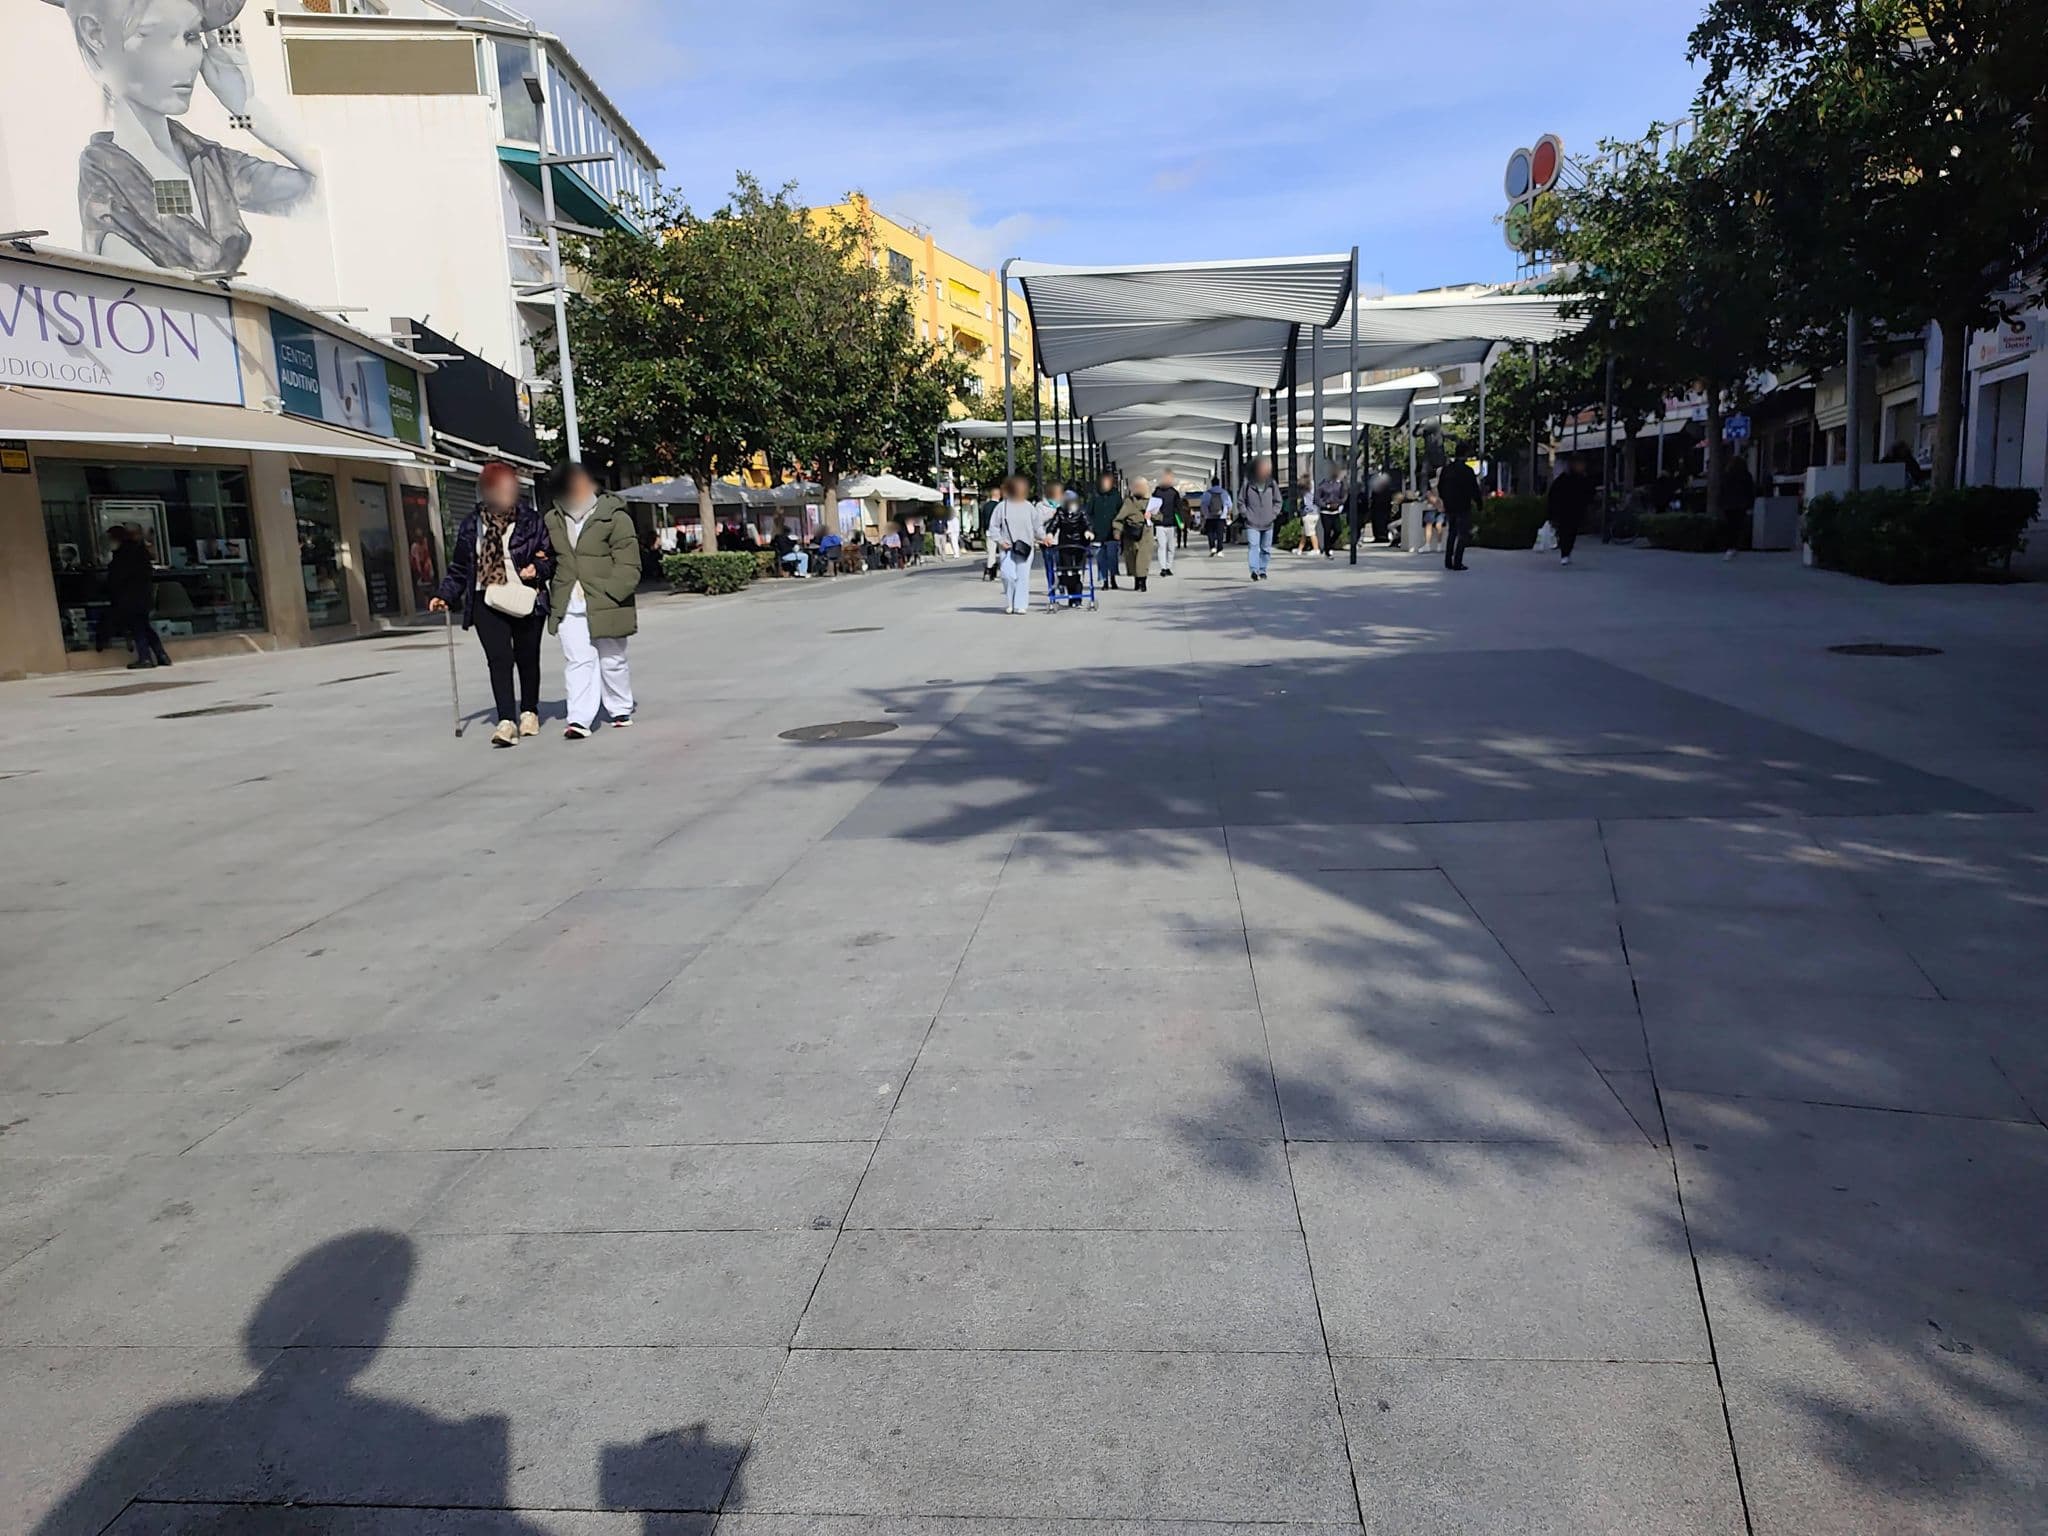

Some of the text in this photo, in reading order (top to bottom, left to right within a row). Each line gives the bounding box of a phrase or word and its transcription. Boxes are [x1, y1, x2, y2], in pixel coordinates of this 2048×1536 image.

[0, 284, 200, 361] VISIÓN
[281, 344, 314, 370] CENTRO
[281, 367, 319, 394] AUDITIVO
